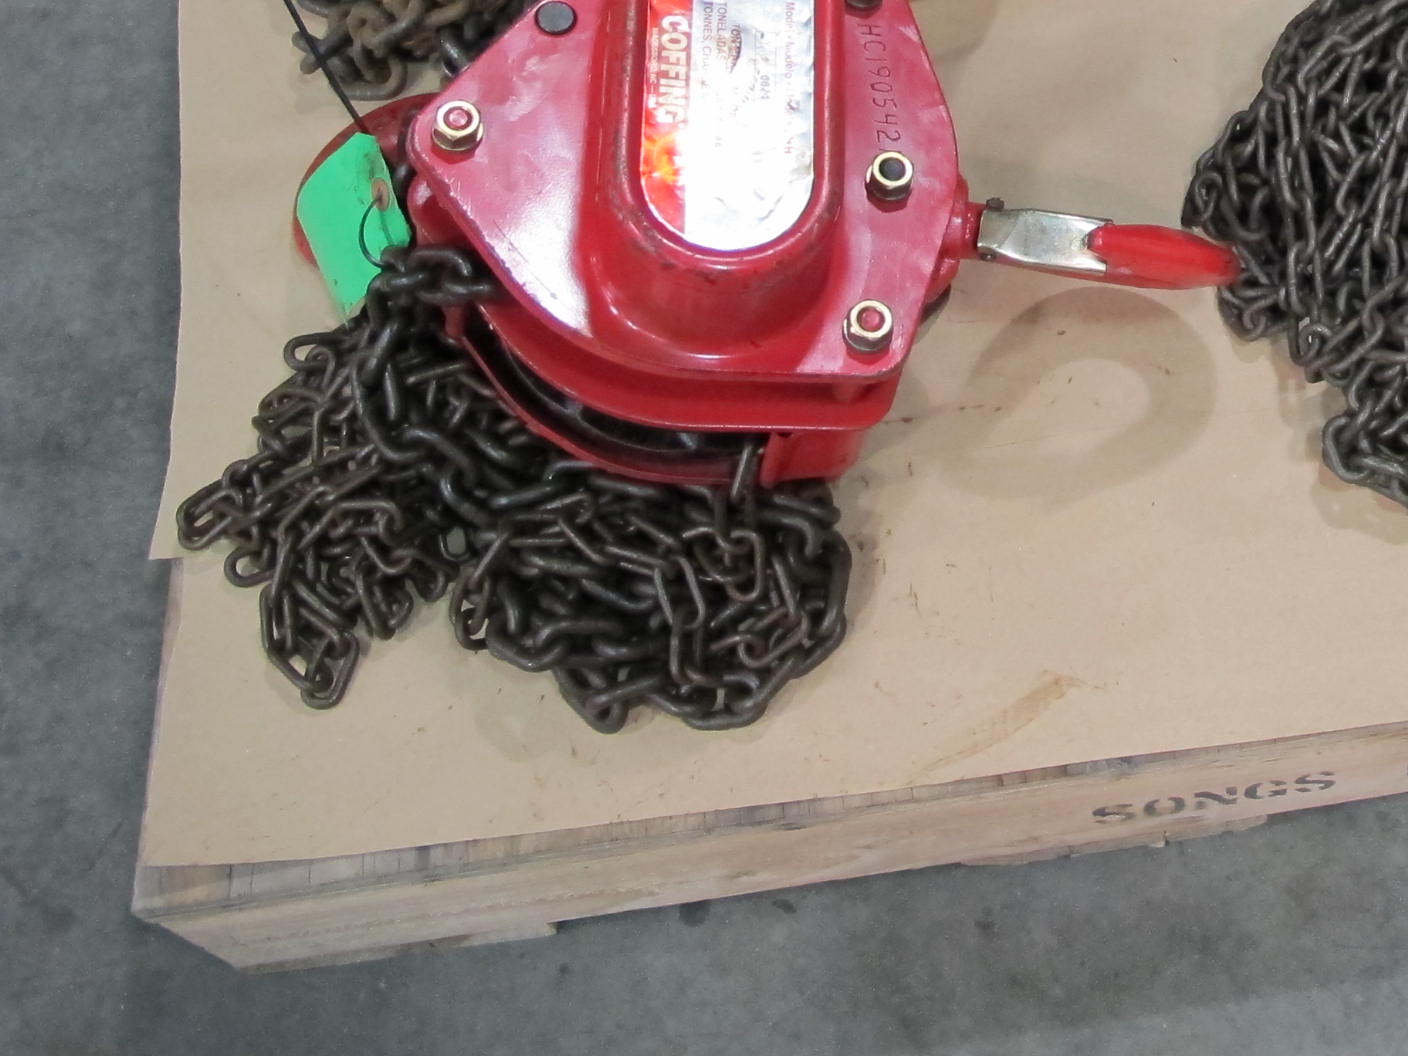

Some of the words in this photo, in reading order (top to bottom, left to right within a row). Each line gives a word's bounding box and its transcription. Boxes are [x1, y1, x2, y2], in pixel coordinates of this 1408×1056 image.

[656, 15, 691, 124] COFFING
[857, 23, 901, 151] HC190542
[1092, 770, 1336, 824] SONGS
